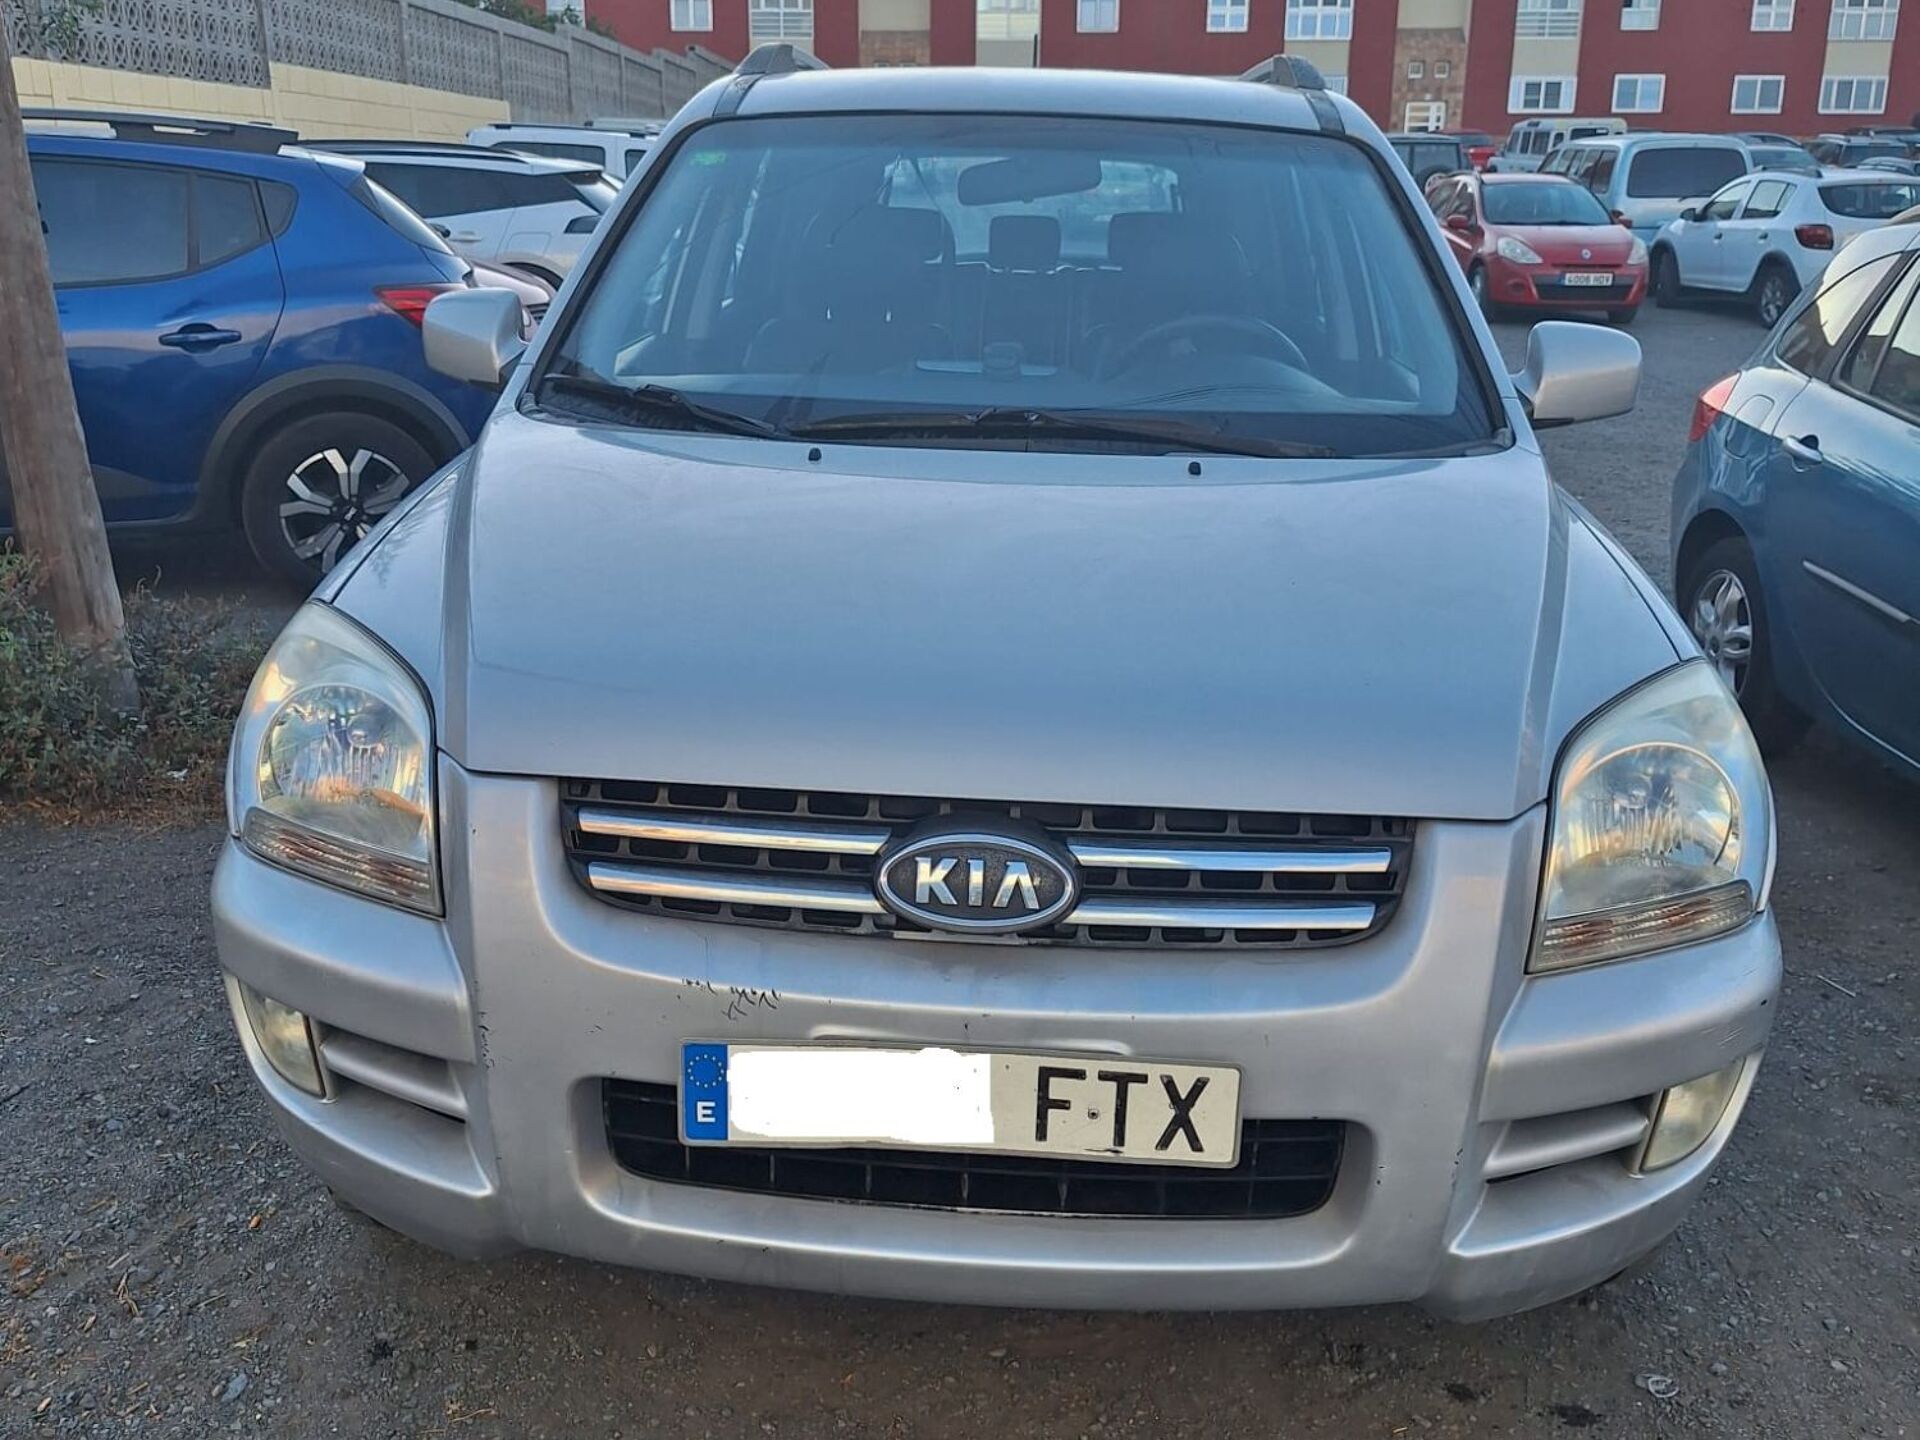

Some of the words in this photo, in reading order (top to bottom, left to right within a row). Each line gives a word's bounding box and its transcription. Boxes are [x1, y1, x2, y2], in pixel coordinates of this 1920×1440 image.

[914, 856, 1040, 910] KIA
[696, 1101, 716, 1122] E
[1035, 1066, 1210, 1153] FTX
